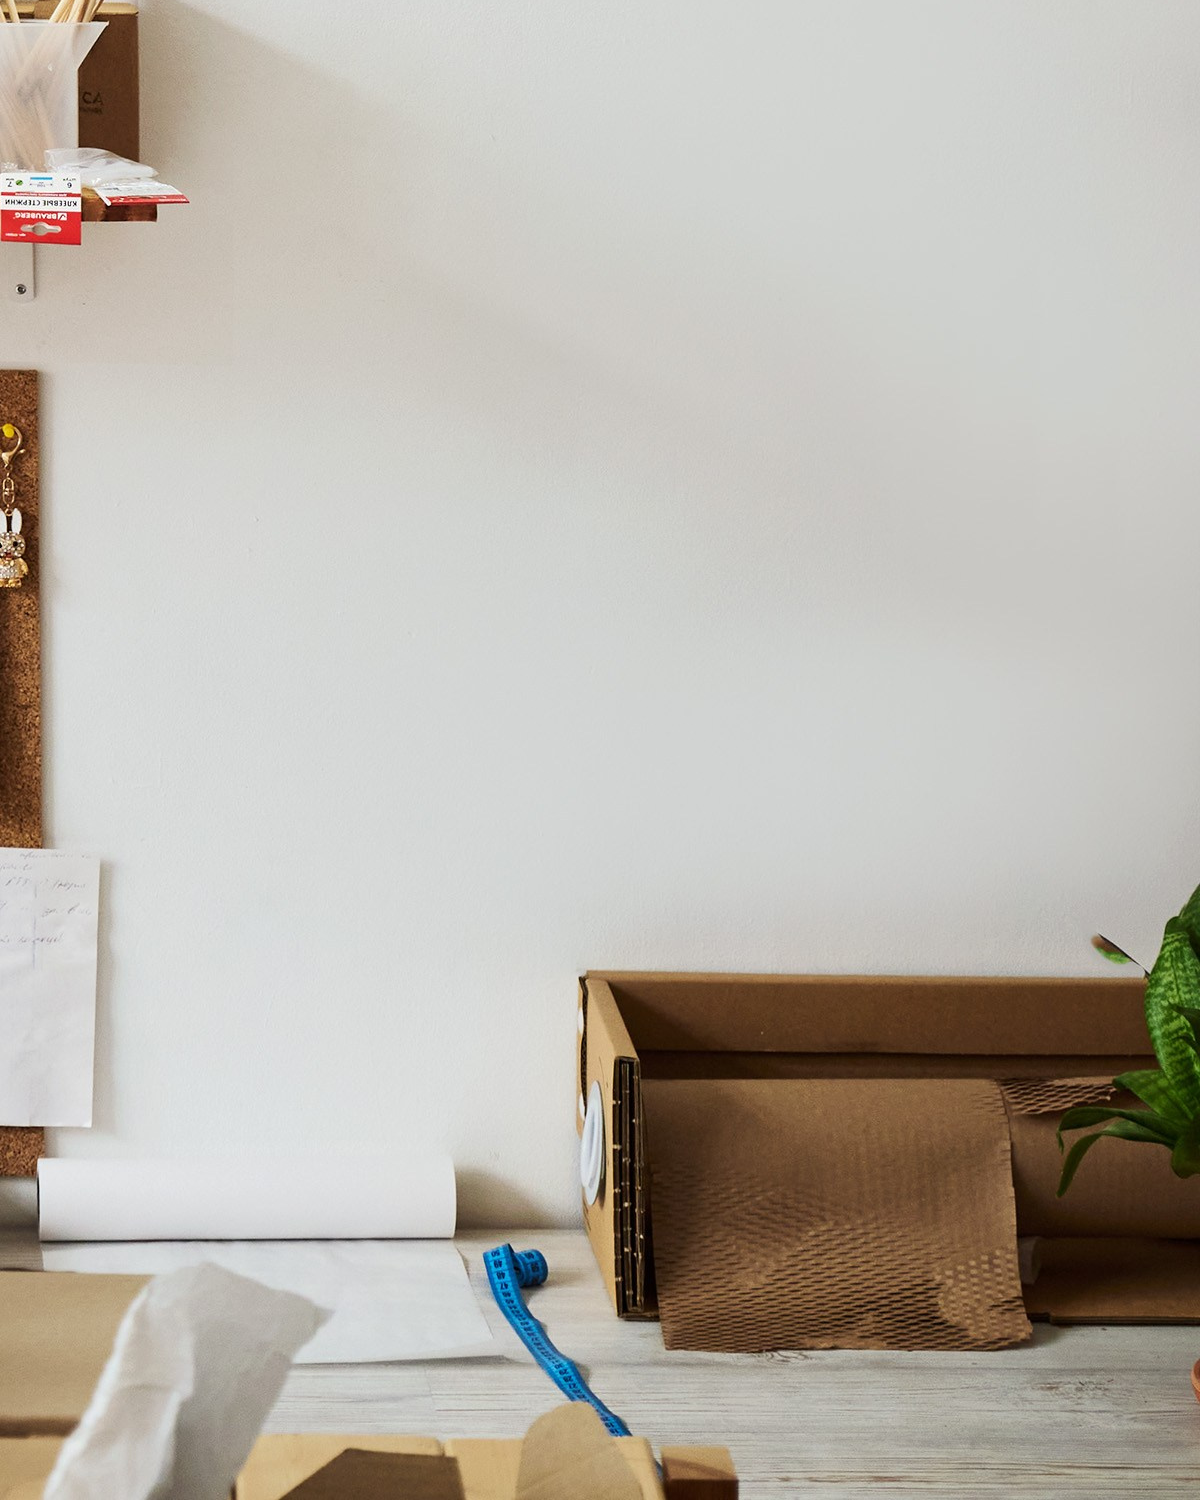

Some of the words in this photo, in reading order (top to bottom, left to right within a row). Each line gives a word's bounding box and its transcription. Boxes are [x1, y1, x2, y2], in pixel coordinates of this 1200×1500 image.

[5, 198, 41, 207] СТЕРЖНИ
[42, 199, 78, 208] КЛЕЕВЫЕ
[15, 211, 58, 221] BRAUBERG
[499, 1282, 509, 1290] 47
